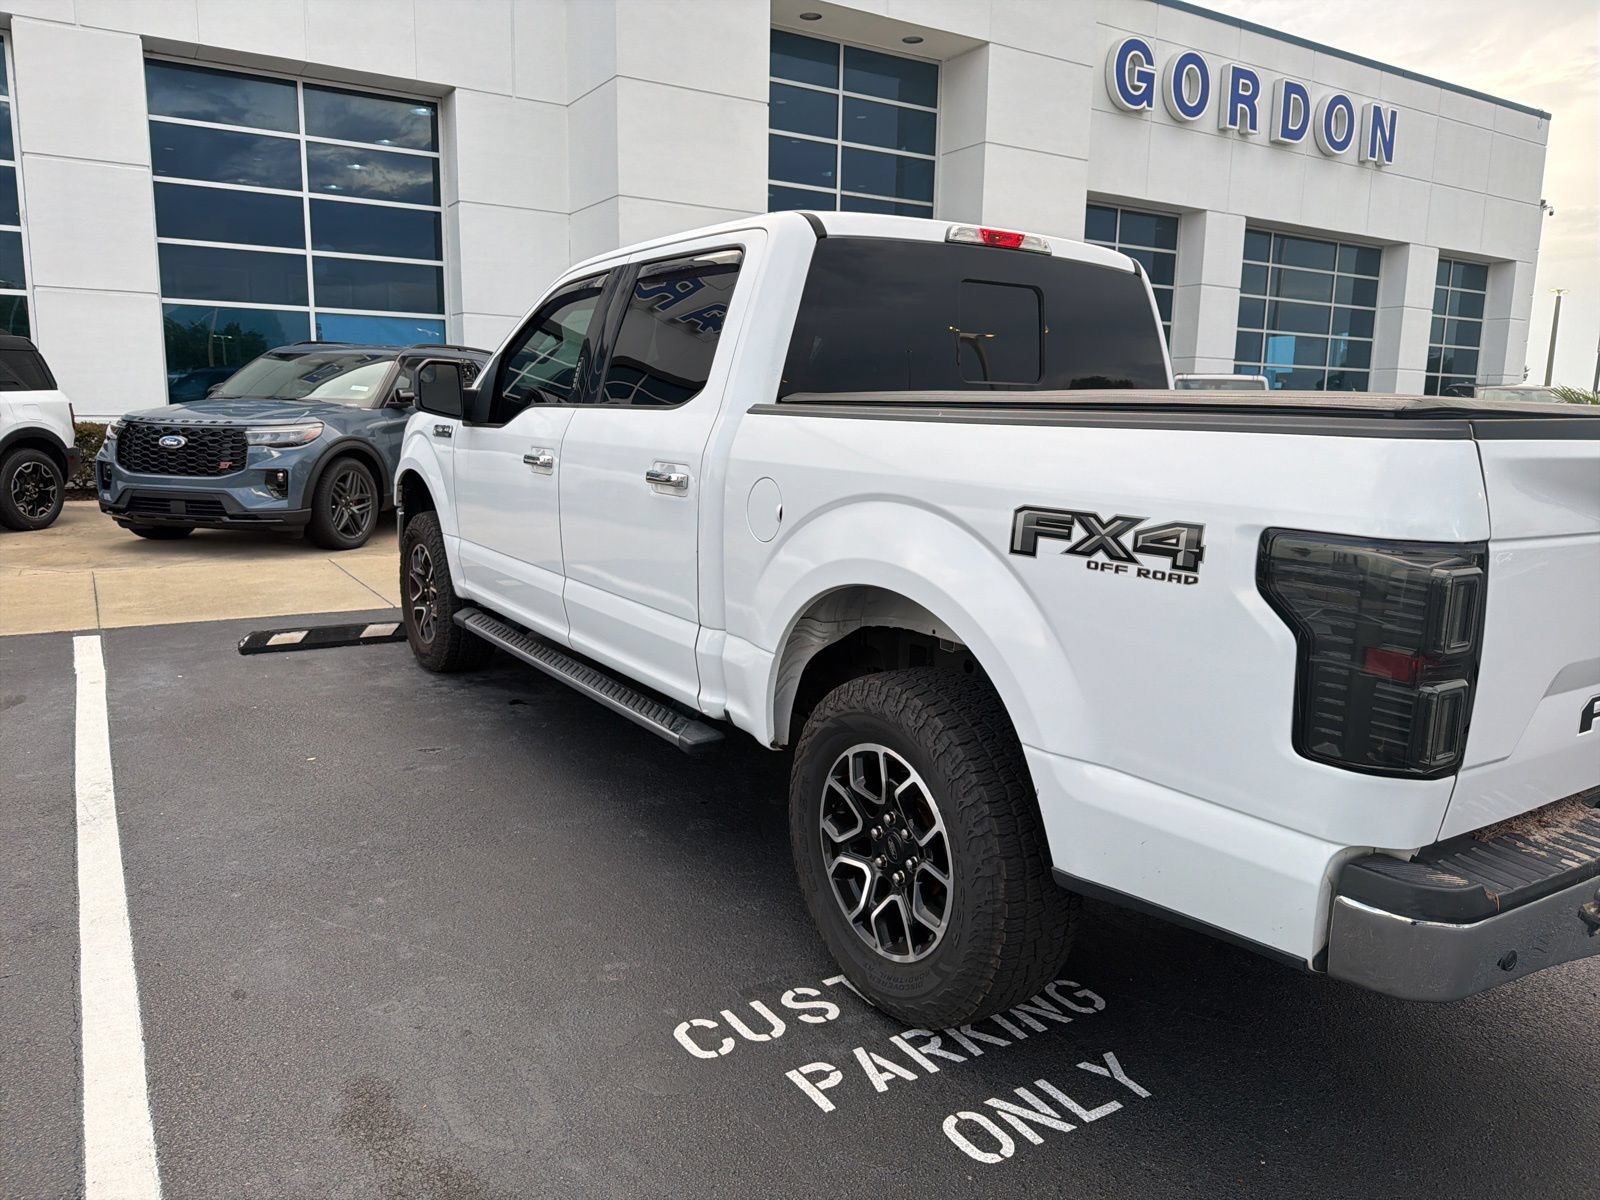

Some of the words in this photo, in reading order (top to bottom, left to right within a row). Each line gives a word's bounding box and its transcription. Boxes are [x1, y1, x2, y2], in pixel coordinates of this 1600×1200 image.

[1106, 37, 1398, 165] GORDON
[1009, 504, 1207, 574] FX4
[1086, 560, 1129, 574] OFF
[1137, 567, 1199, 585] ROAD
[785, 979, 1106, 1113] PARKING
[941, 1051, 1152, 1164] ONLY
